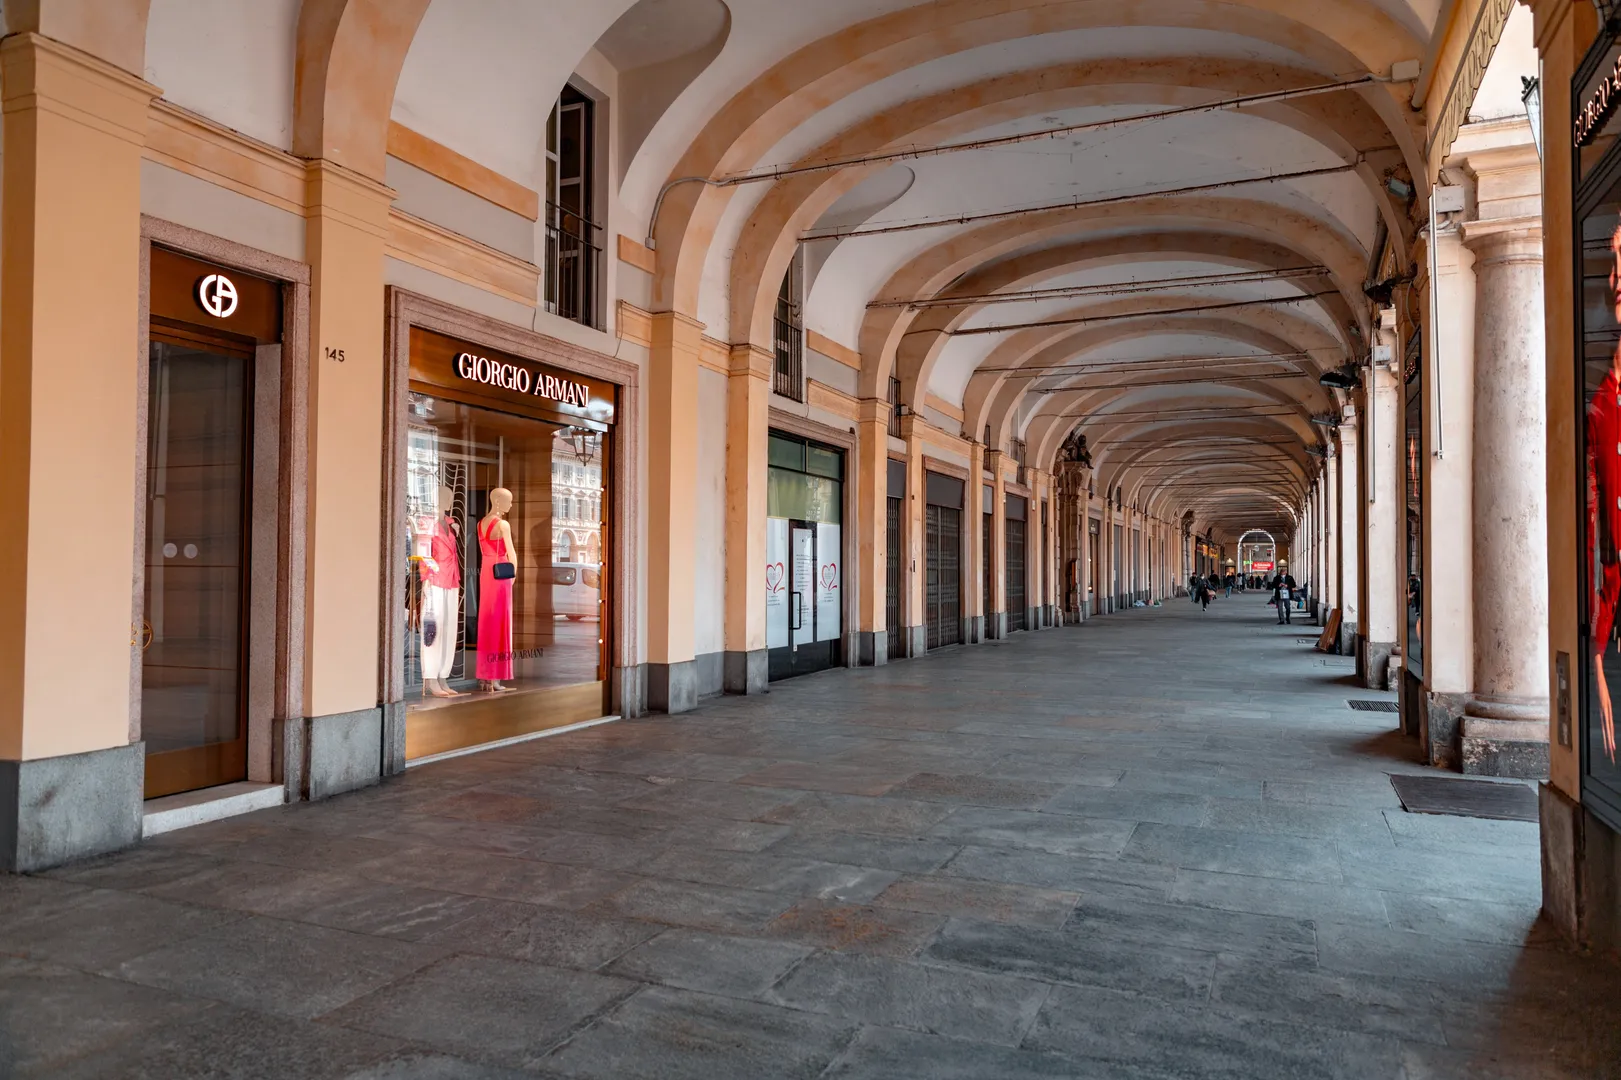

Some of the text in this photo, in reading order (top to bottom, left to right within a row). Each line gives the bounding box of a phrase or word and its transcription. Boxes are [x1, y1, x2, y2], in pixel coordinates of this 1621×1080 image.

[1573, 77, 1610, 147] GIORGIO
[325, 347, 345, 362] 145
[458, 353, 589, 407] GIORGIO ARMANI
[519, 648, 544, 659] ARMANI
